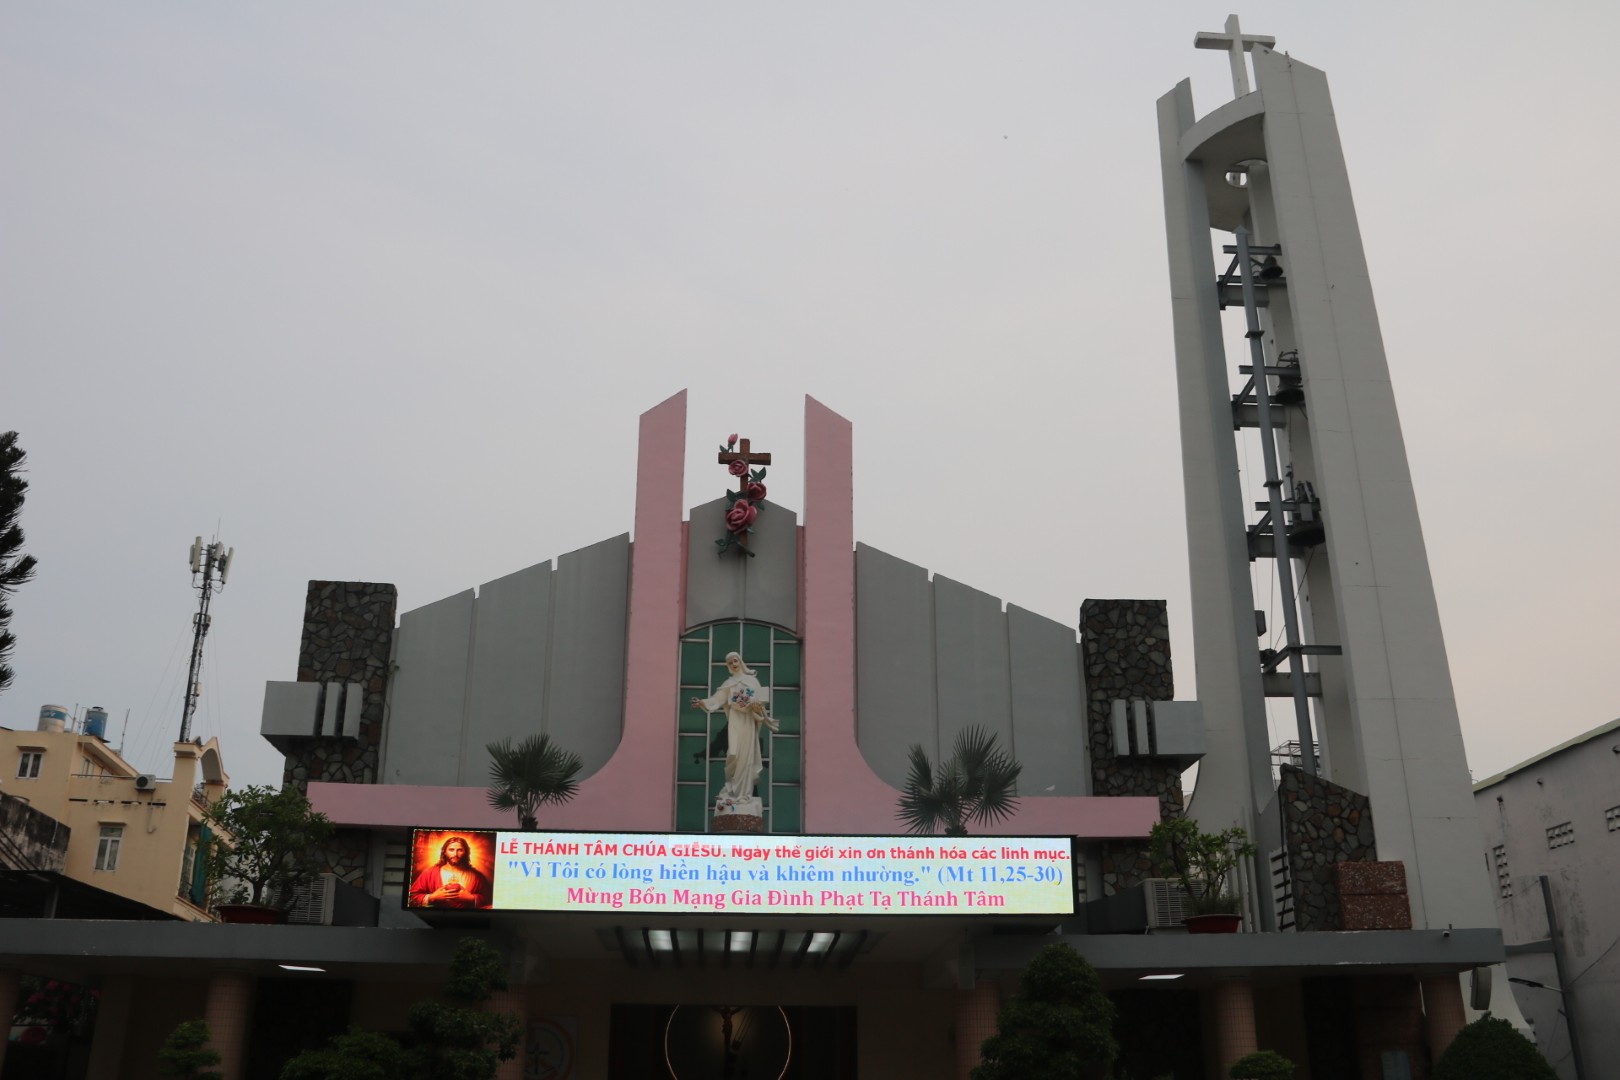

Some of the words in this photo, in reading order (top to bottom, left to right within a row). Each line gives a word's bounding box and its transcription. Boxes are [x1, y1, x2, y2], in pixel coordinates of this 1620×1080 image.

[500, 838, 519, 855] LỄ
[523, 839, 579, 856] THÁNH
[584, 840, 618, 857] TÂM
[622, 841, 667, 857] CHÚA
[731, 845, 771, 861] Ngày
[775, 845, 801, 859] thế
[805, 846, 834, 862] giới
[838, 846, 862, 859] xin
[866, 848, 886, 859] ơn
[890, 846, 935, 860] thánh
[939, 847, 967, 860] hóa
[971, 847, 997, 860] các
[1001, 847, 1029, 860] linh
[1033, 849, 1070, 862] mục.
[508, 861, 541, 878] "Vì
[548, 861, 579, 879] Tôi
[585, 863, 606, 879] có
[612, 864, 653, 884] lòng
[660, 859, 699, 880] hiền
[706, 864, 741, 885] hậu
[748, 865, 769, 881] và
[776, 865, 835, 882] khiêm
[842, 865, 931, 887] nhường."
[937, 866, 974, 886] (Mt
[981, 866, 1063, 886] 11,25-30)
[567, 887, 624, 908] Mừng
[629, 886, 667, 905] Bổn
[673, 889, 726, 909] Mạng
[731, 890, 762, 906] Gia
[768, 890, 813, 906] Đình
[820, 890, 864, 910] Phạt
[869, 891, 892, 910] Tạ
[897, 891, 958, 907] Thánh
[963, 891, 1005, 907] Tâm
